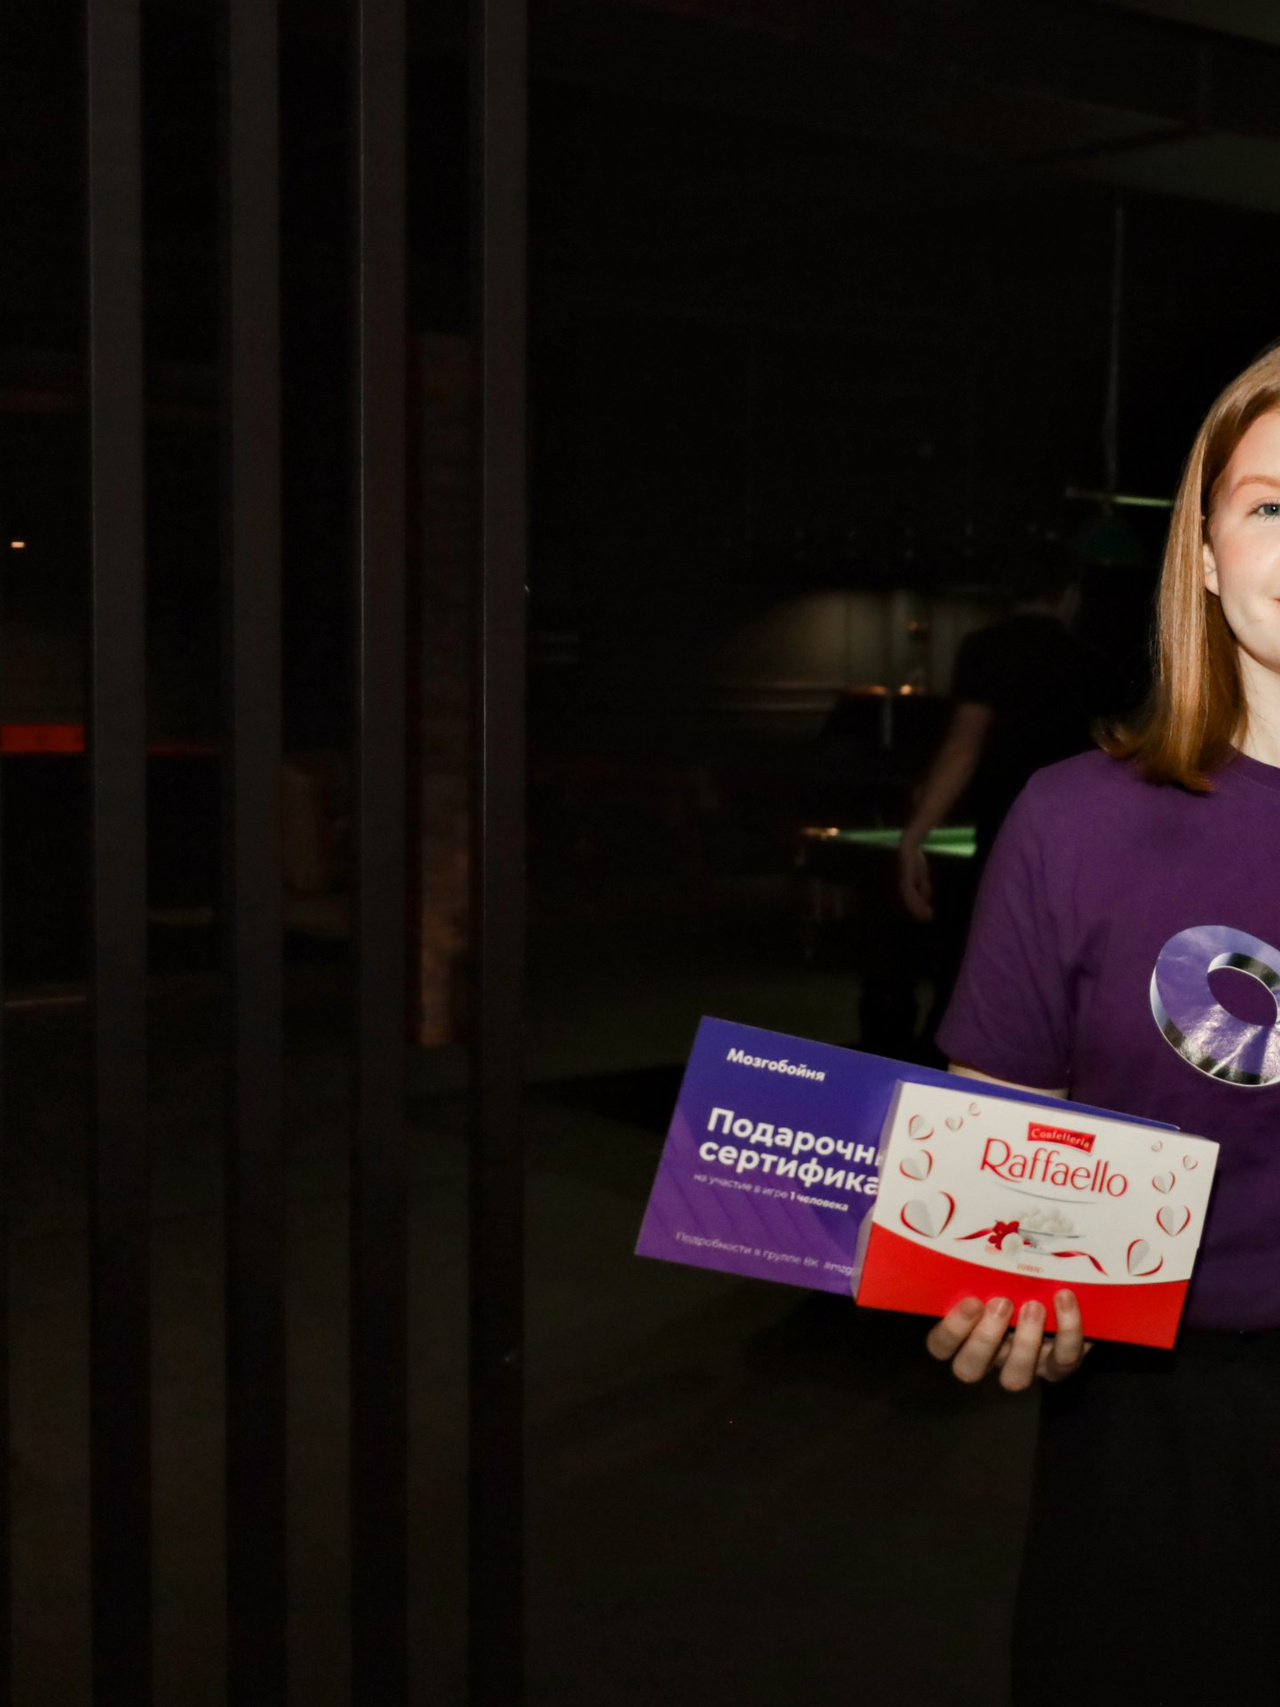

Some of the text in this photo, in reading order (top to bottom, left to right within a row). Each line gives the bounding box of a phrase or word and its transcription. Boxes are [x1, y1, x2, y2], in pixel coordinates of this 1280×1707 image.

[726, 1047, 826, 1082] Мозгобойня
[707, 1107, 882, 1168] Подарочн
[979, 1137, 1129, 1197] Raffaello
[694, 1174, 849, 1212] на участие в игре 1 человека
[675, 1231, 752, 1255] Подробности
[753, 1249, 761, 1257] в
[762, 1250, 801, 1265] группе
